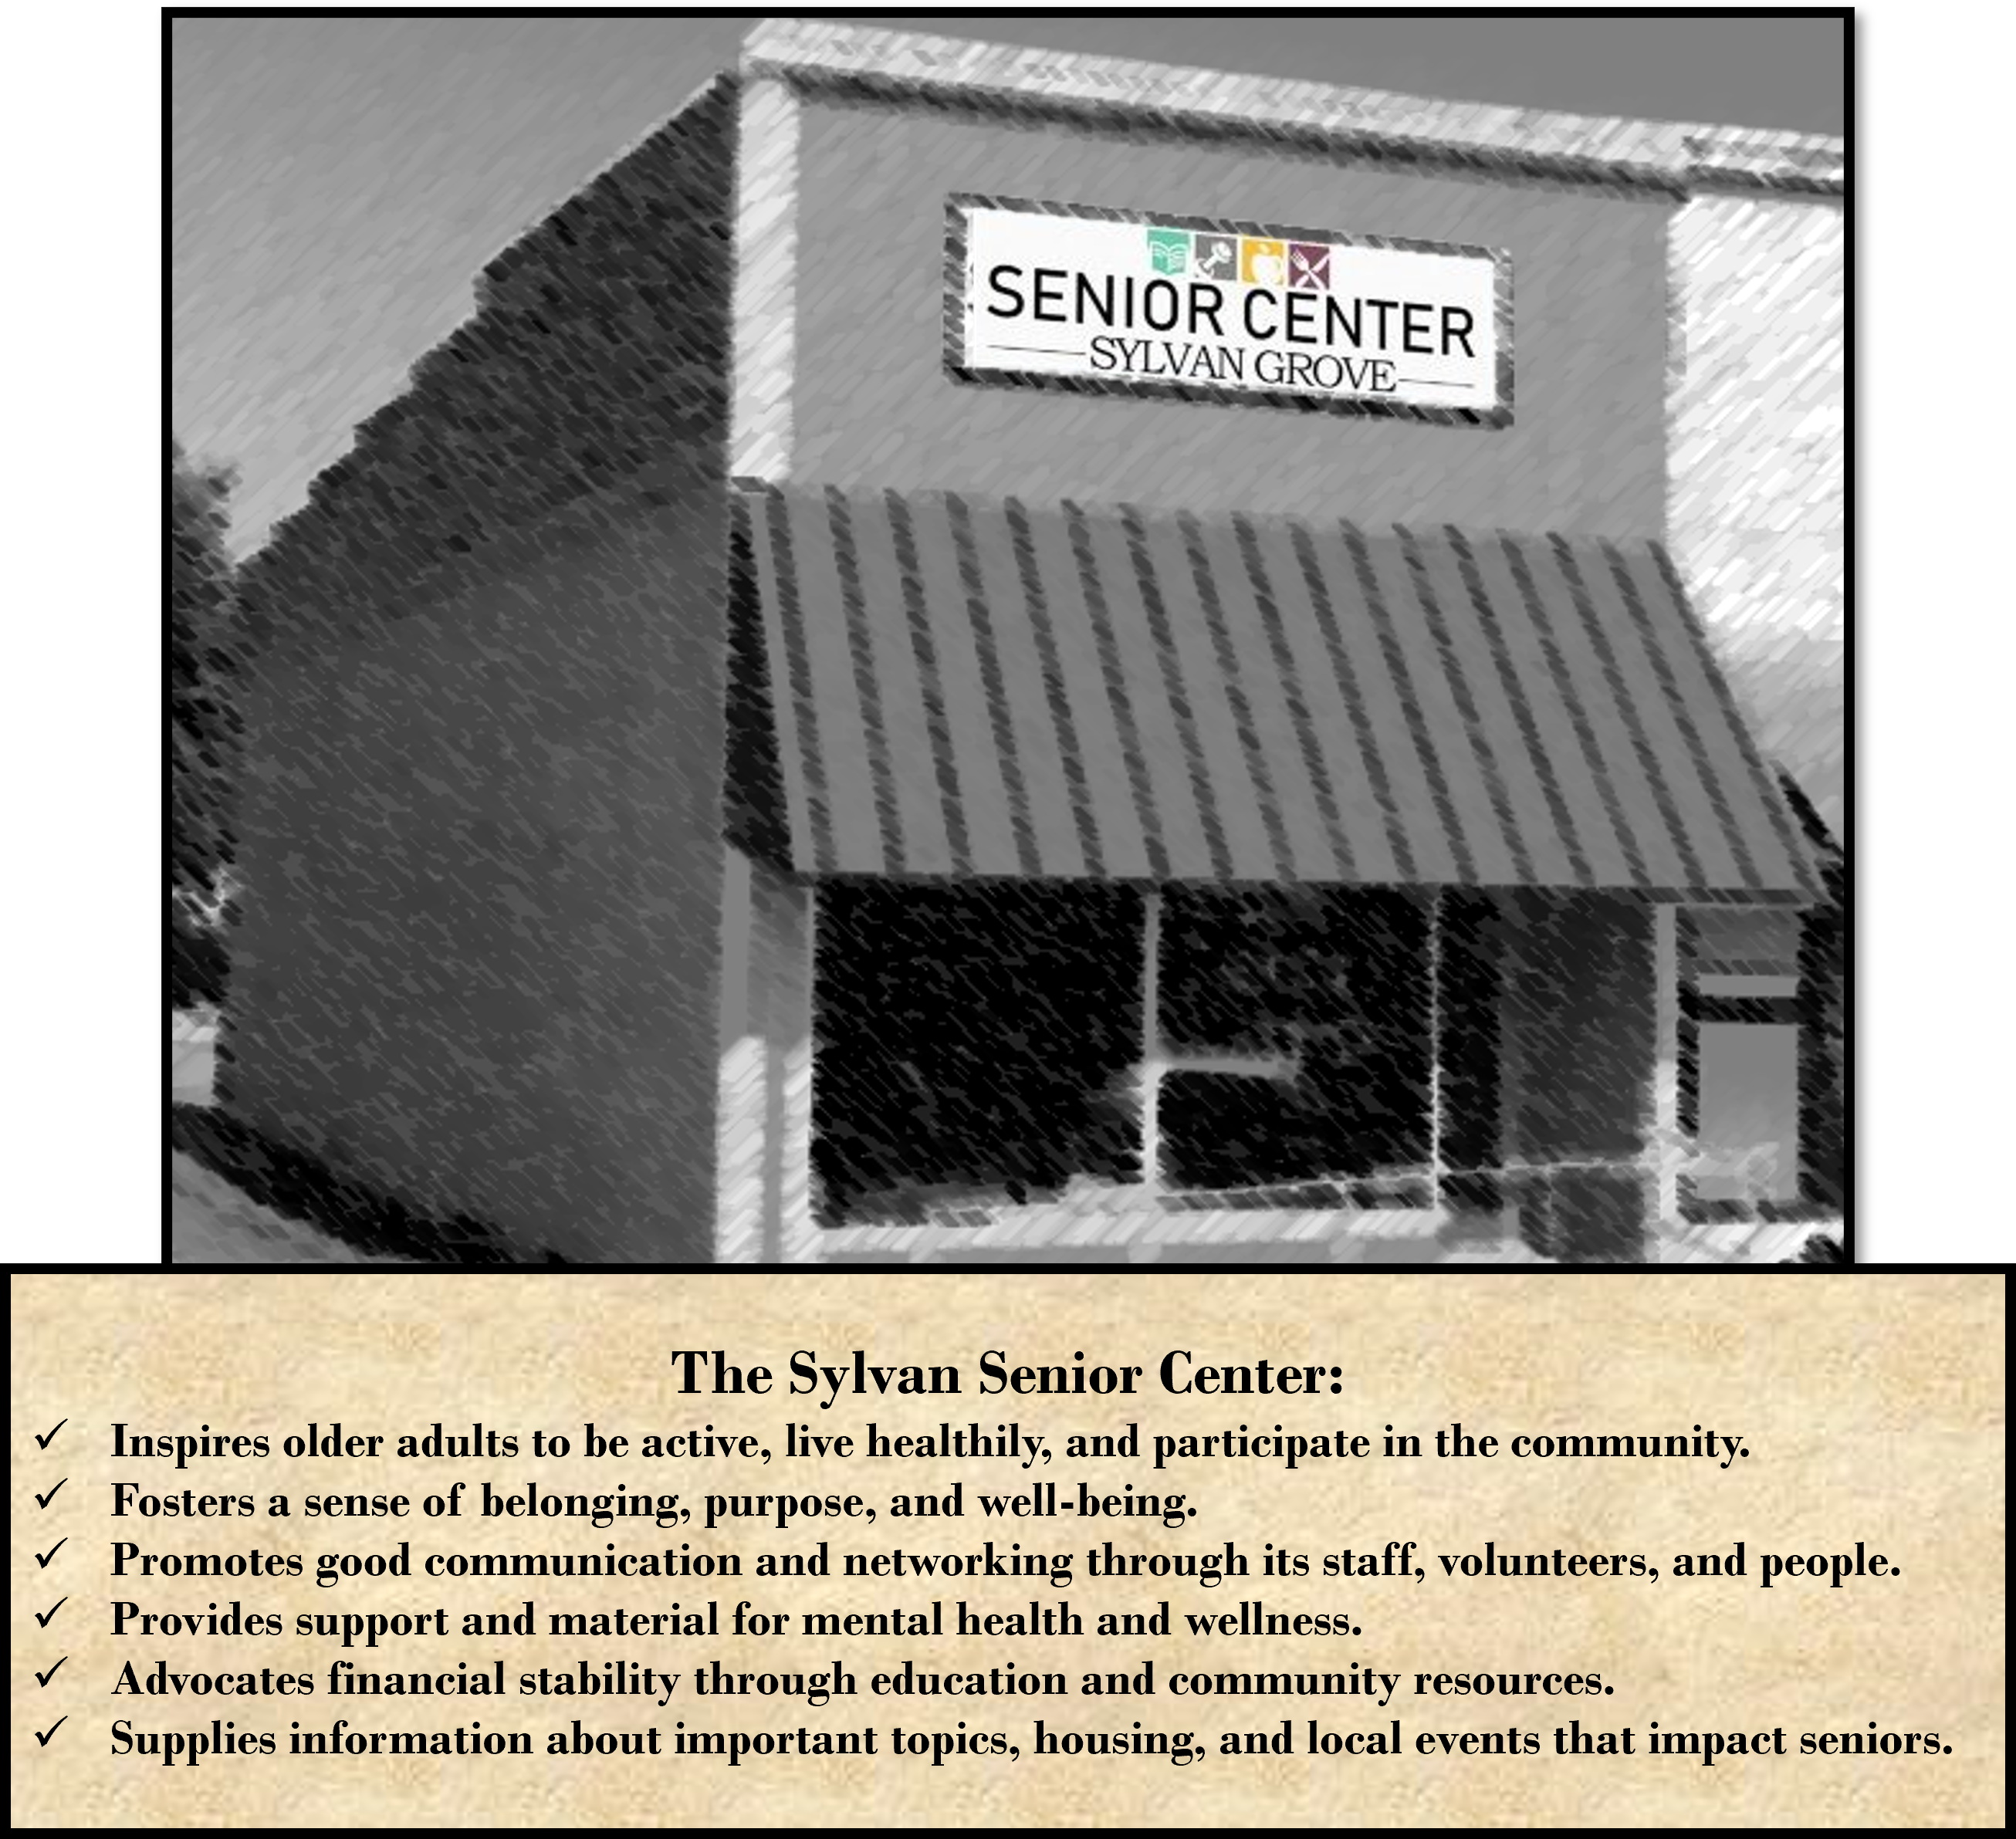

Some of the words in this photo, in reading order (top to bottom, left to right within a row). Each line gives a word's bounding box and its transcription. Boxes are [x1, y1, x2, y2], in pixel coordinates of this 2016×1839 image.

[986, 264, 1225, 336] SENIOR
[1242, 287, 1476, 358] CENTER
[1090, 336, 1246, 381] SYLVAN
[1253, 350, 1397, 394] GROVE
